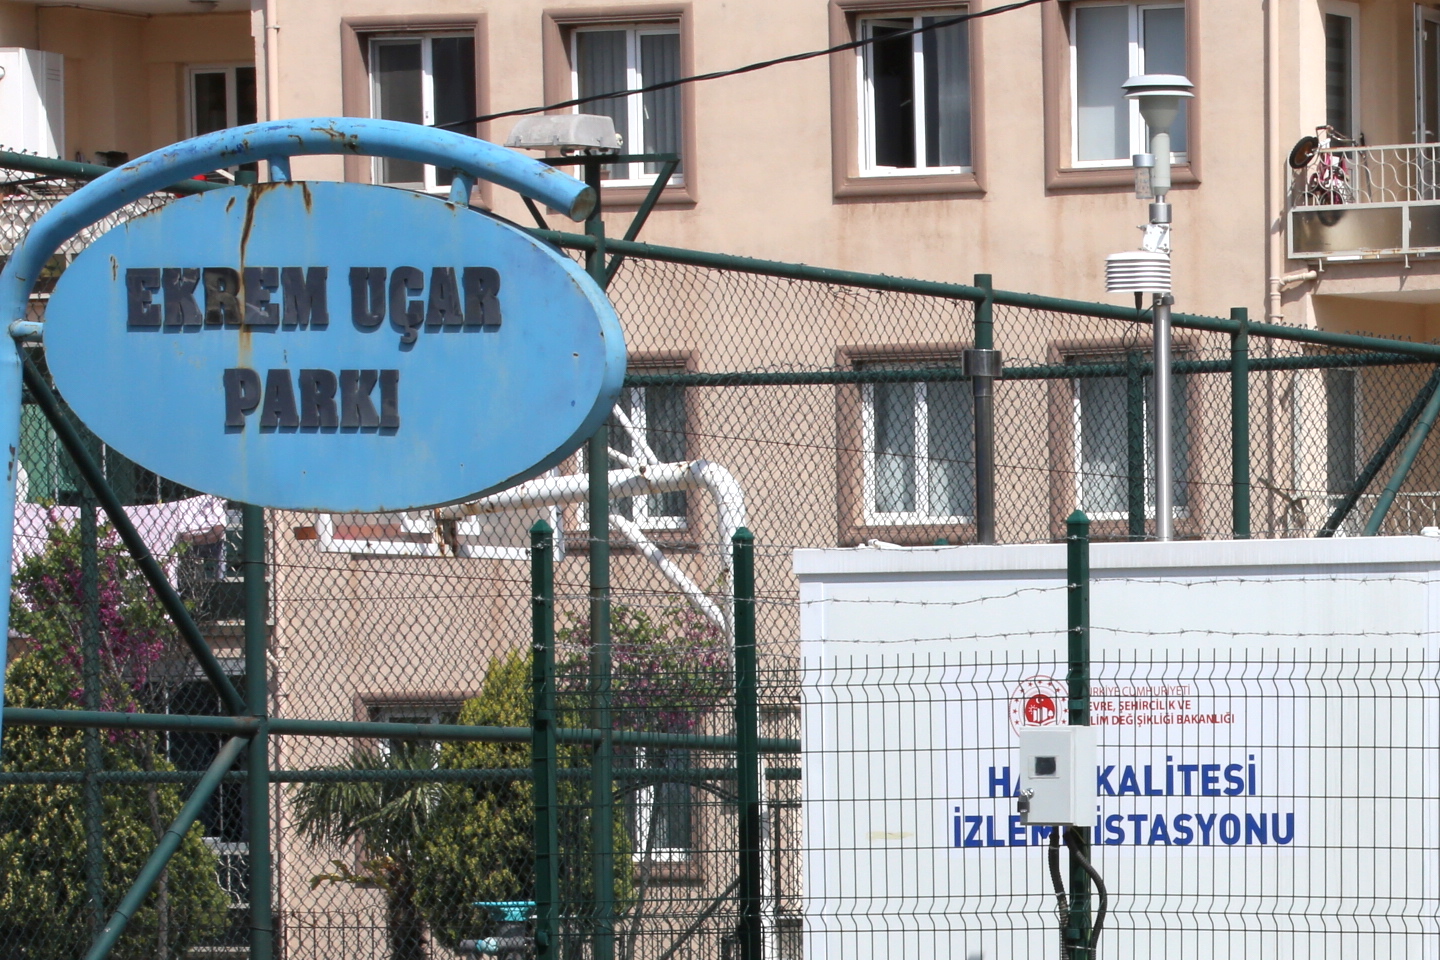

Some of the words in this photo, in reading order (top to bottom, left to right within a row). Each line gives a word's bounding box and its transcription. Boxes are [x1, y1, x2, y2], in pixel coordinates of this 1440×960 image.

[126, 266, 329, 332] EKREM
[349, 266, 501, 349] UÇAR
[223, 368, 399, 432] PARKI
[1090, 684, 1120, 696] RKİYE
[1090, 701, 1116, 712] EVRE,
[1178, 700, 1191, 710] VE
[1090, 714, 1109, 726] LİM
[1112, 713, 1175, 728] DEĞŞİKLİĞİ
[1177, 712, 1235, 725] BAKANLIĞI
[1097, 754, 1257, 796] KALİTESİ
[1094, 805, 1295, 847] İSTASYONU
